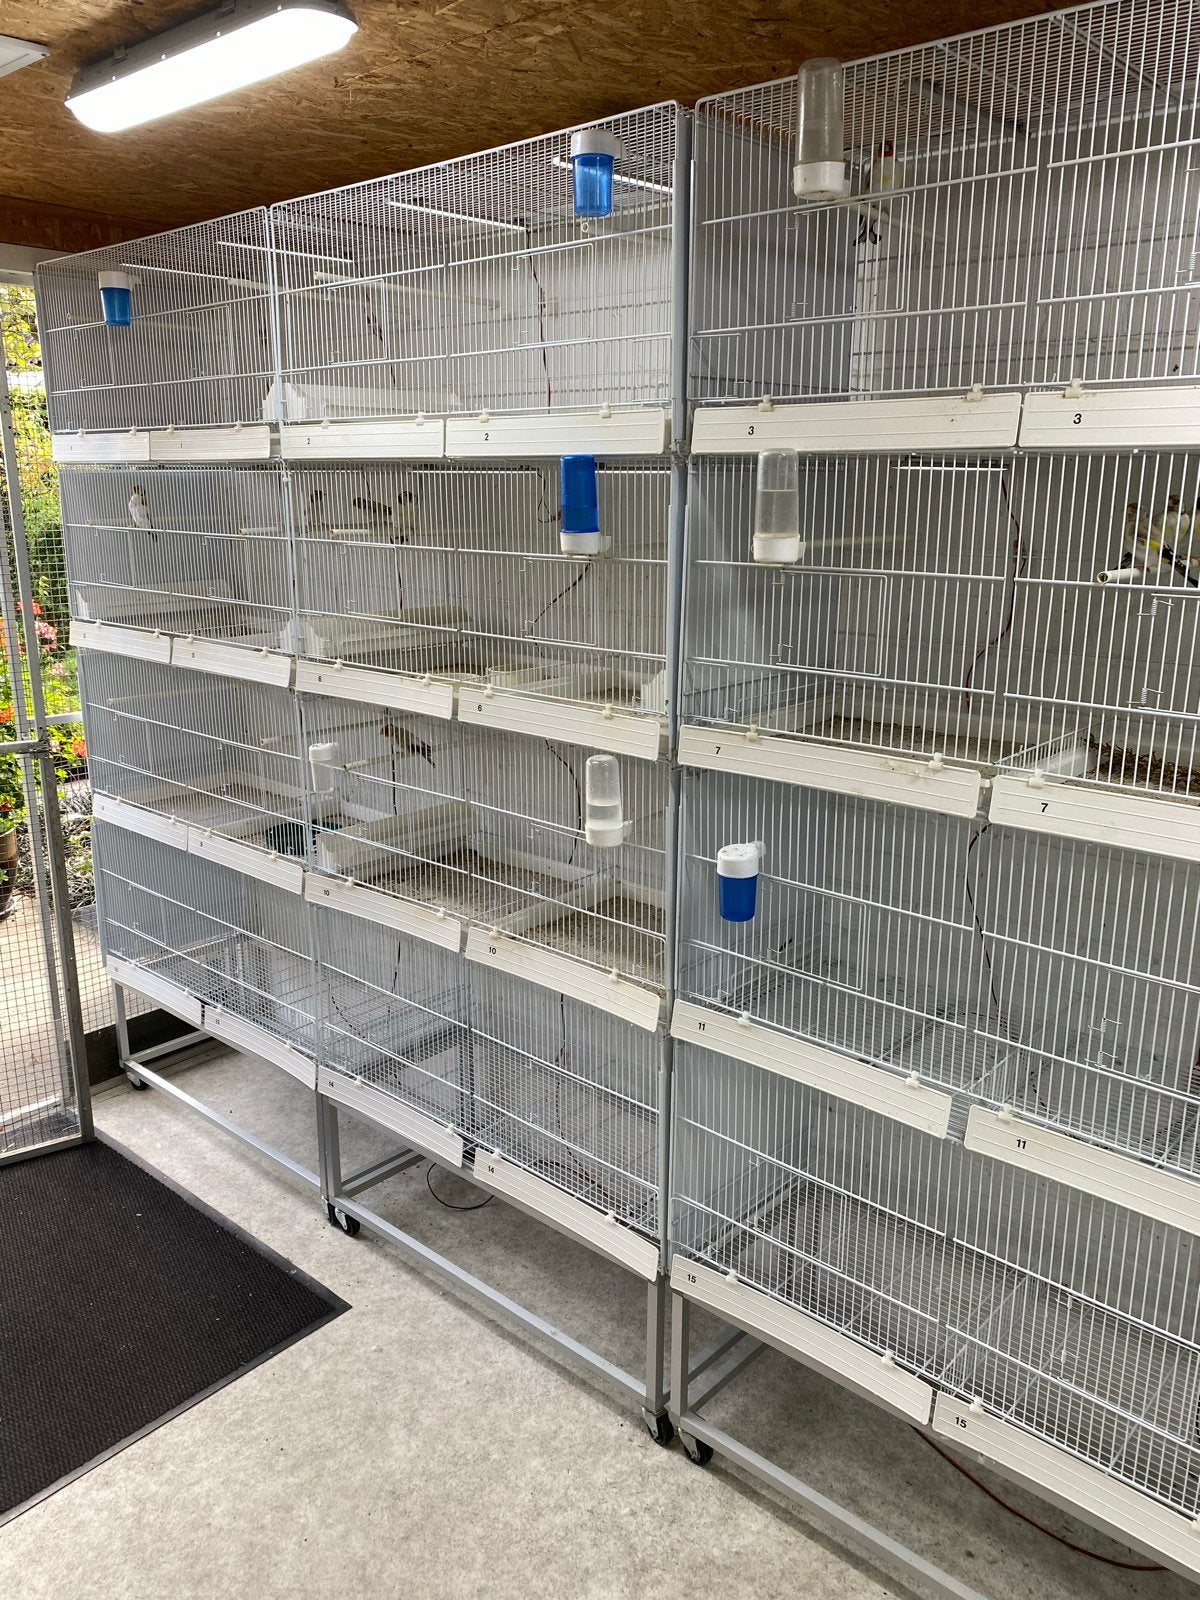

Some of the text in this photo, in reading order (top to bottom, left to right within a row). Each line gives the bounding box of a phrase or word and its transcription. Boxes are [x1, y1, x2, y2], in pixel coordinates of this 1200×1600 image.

[1073, 413, 1082, 425] 3
[747, 425, 755, 436] 3
[307, 437, 311, 445] 2
[485, 432, 490, 441] 2
[478, 704, 483, 712] 6
[716, 746, 721, 755] 7
[1041, 802, 1049, 812] 7
[323, 889, 329, 897] 10
[489, 946, 497, 955] 10
[698, 1022, 706, 1031] 11
[328, 1081, 334, 1089] 14
[1017, 1138, 1026, 1149] 11
[488, 1165, 495, 1174] 14
[687, 1274, 696, 1283] 15
[956, 1416, 967, 1429] 15
